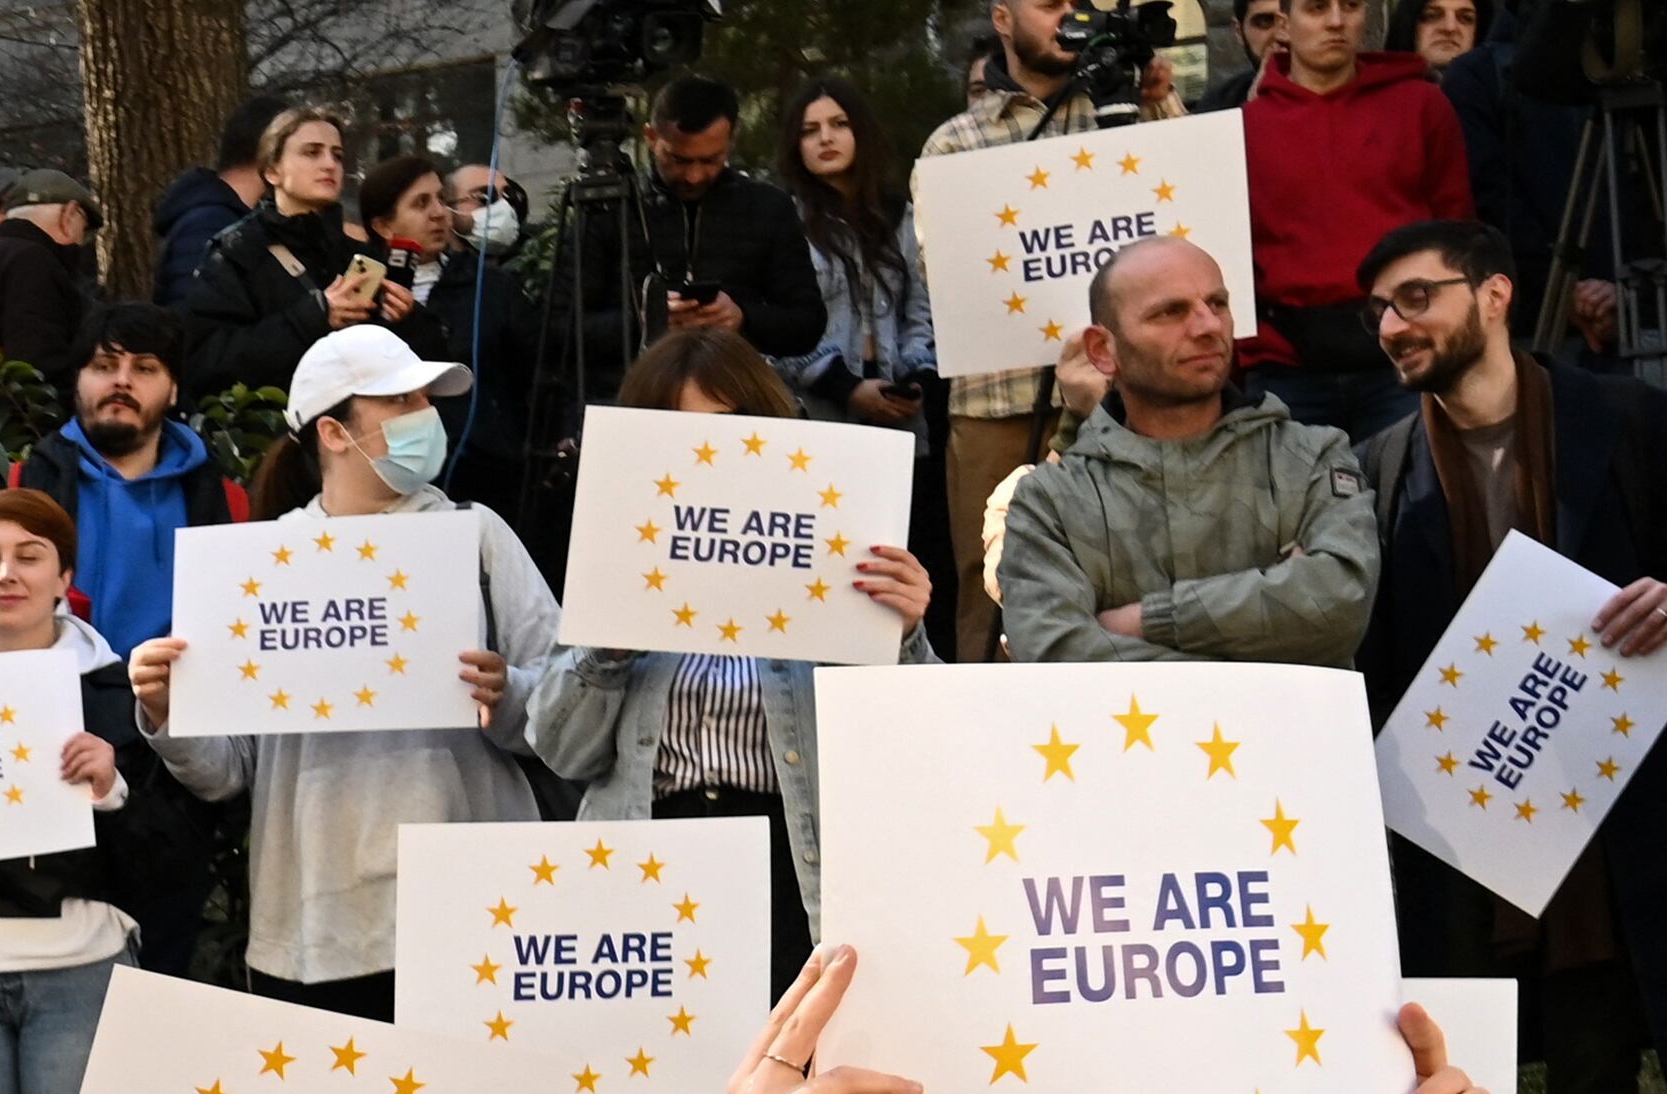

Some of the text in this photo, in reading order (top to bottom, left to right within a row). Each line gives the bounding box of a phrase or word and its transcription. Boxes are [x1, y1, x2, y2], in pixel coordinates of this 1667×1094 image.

[1018, 211, 1156, 255] WE ARE
[1022, 247, 1116, 283] EURO
[673, 505, 816, 540] WE ARE
[669, 535, 813, 569] EUROPE
[258, 597, 387, 625] WE ARE
[259, 624, 389, 651] EUROPE
[1468, 651, 1562, 773] WE ARE
[1494, 665, 1588, 791] EUROPE
[1022, 870, 1275, 936] WE ARE
[513, 931, 673, 966] WE ARE
[513, 968, 674, 1001] EUROPE
[1030, 938, 1286, 1005] EUROPE
